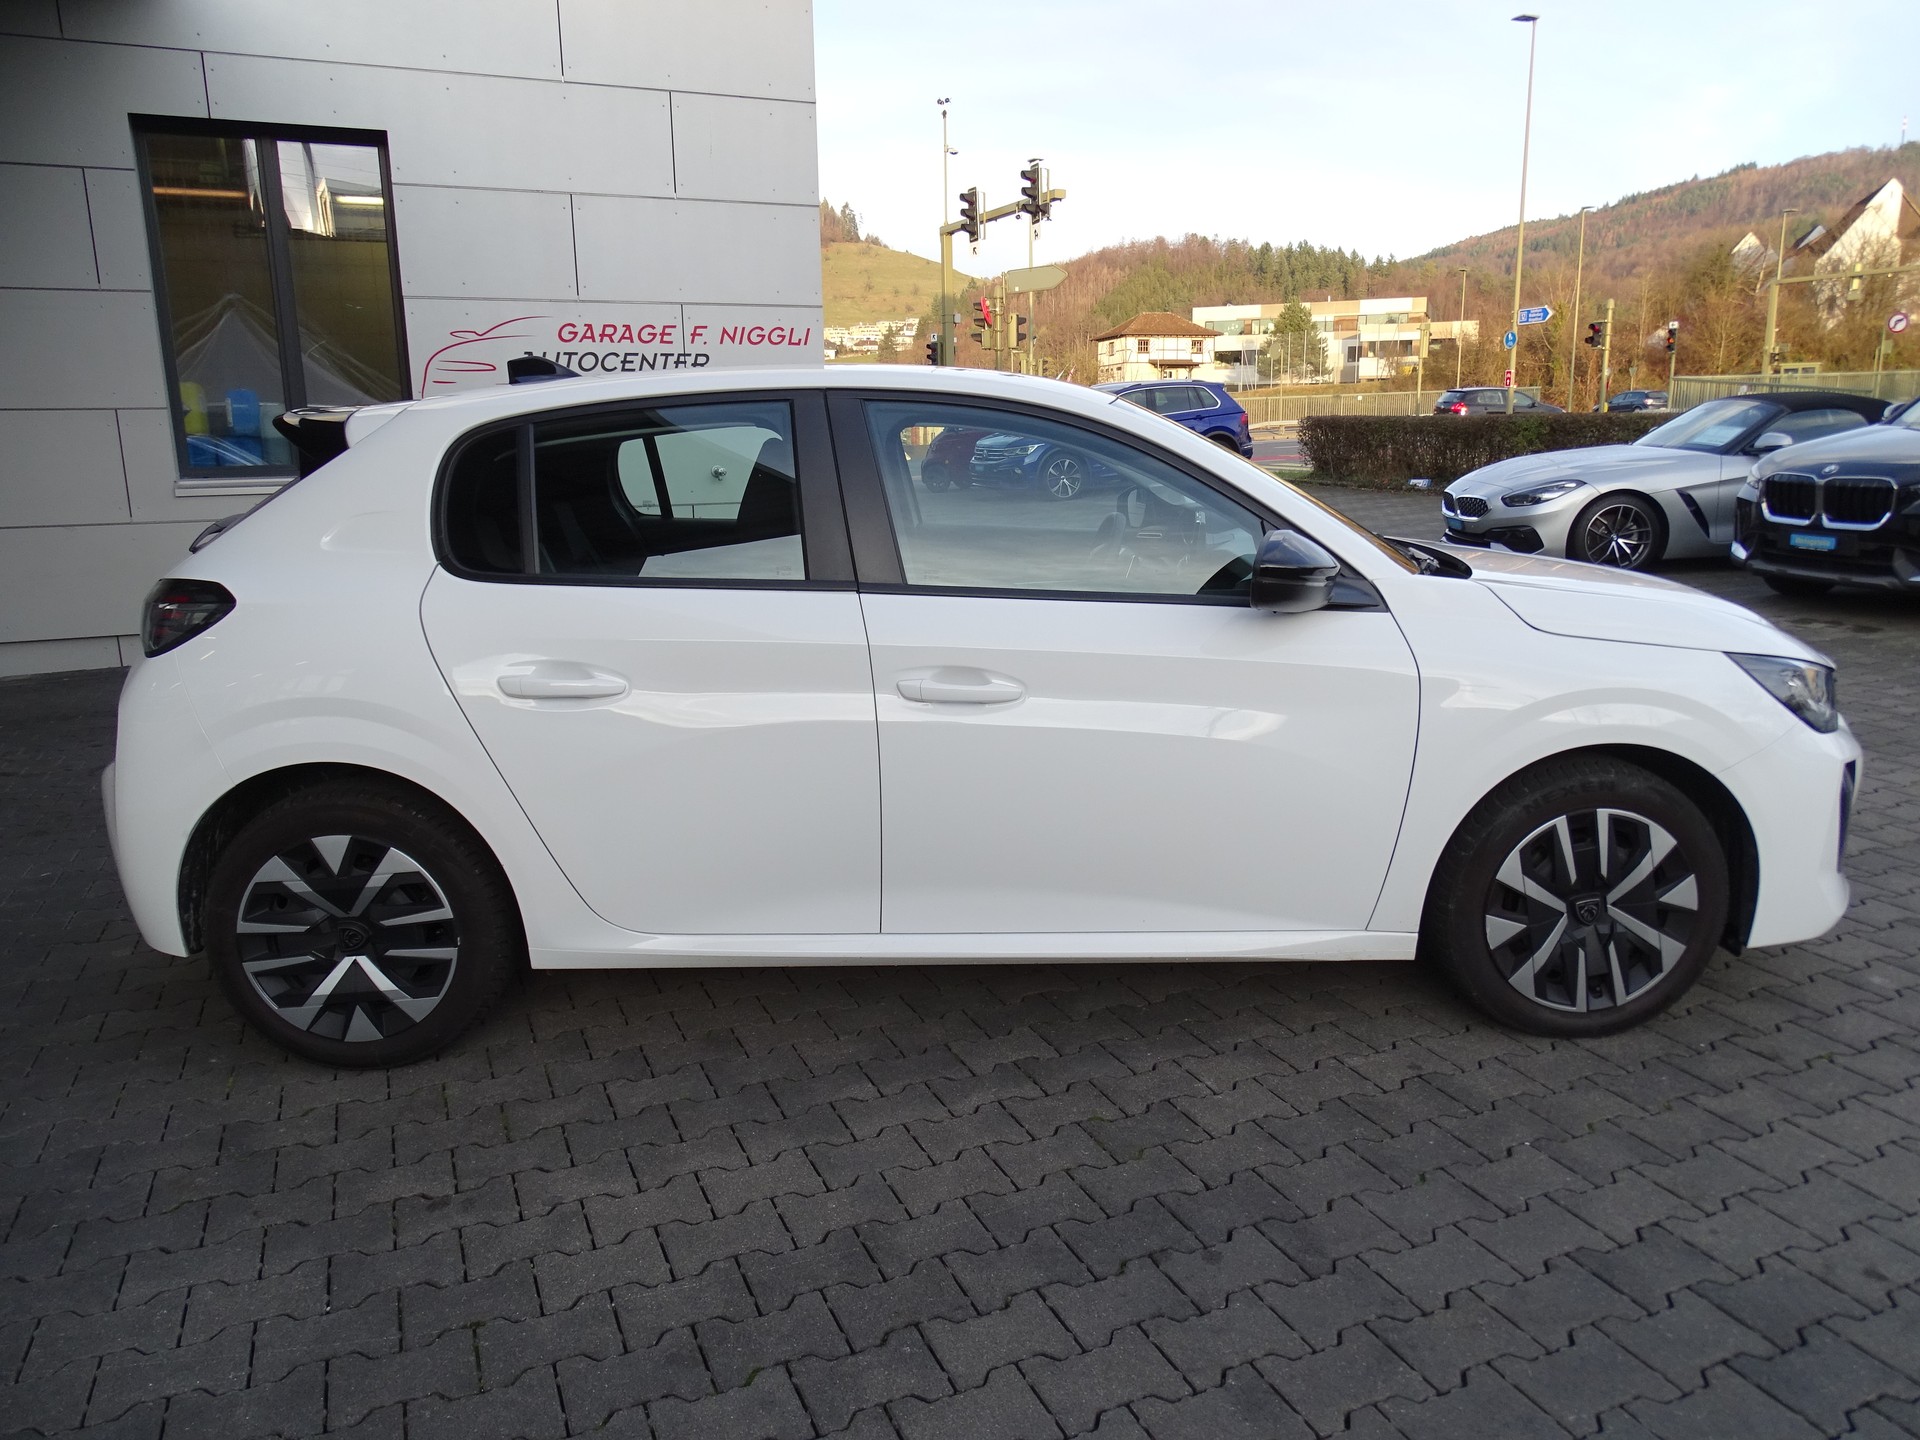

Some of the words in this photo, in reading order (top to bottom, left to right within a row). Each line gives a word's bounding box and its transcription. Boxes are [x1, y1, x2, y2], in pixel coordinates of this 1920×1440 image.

[557, 322, 677, 345] GARAGE
[689, 325, 708, 345] F.
[719, 326, 812, 346] NIGGLI
[523, 351, 711, 373] TOCENTER
